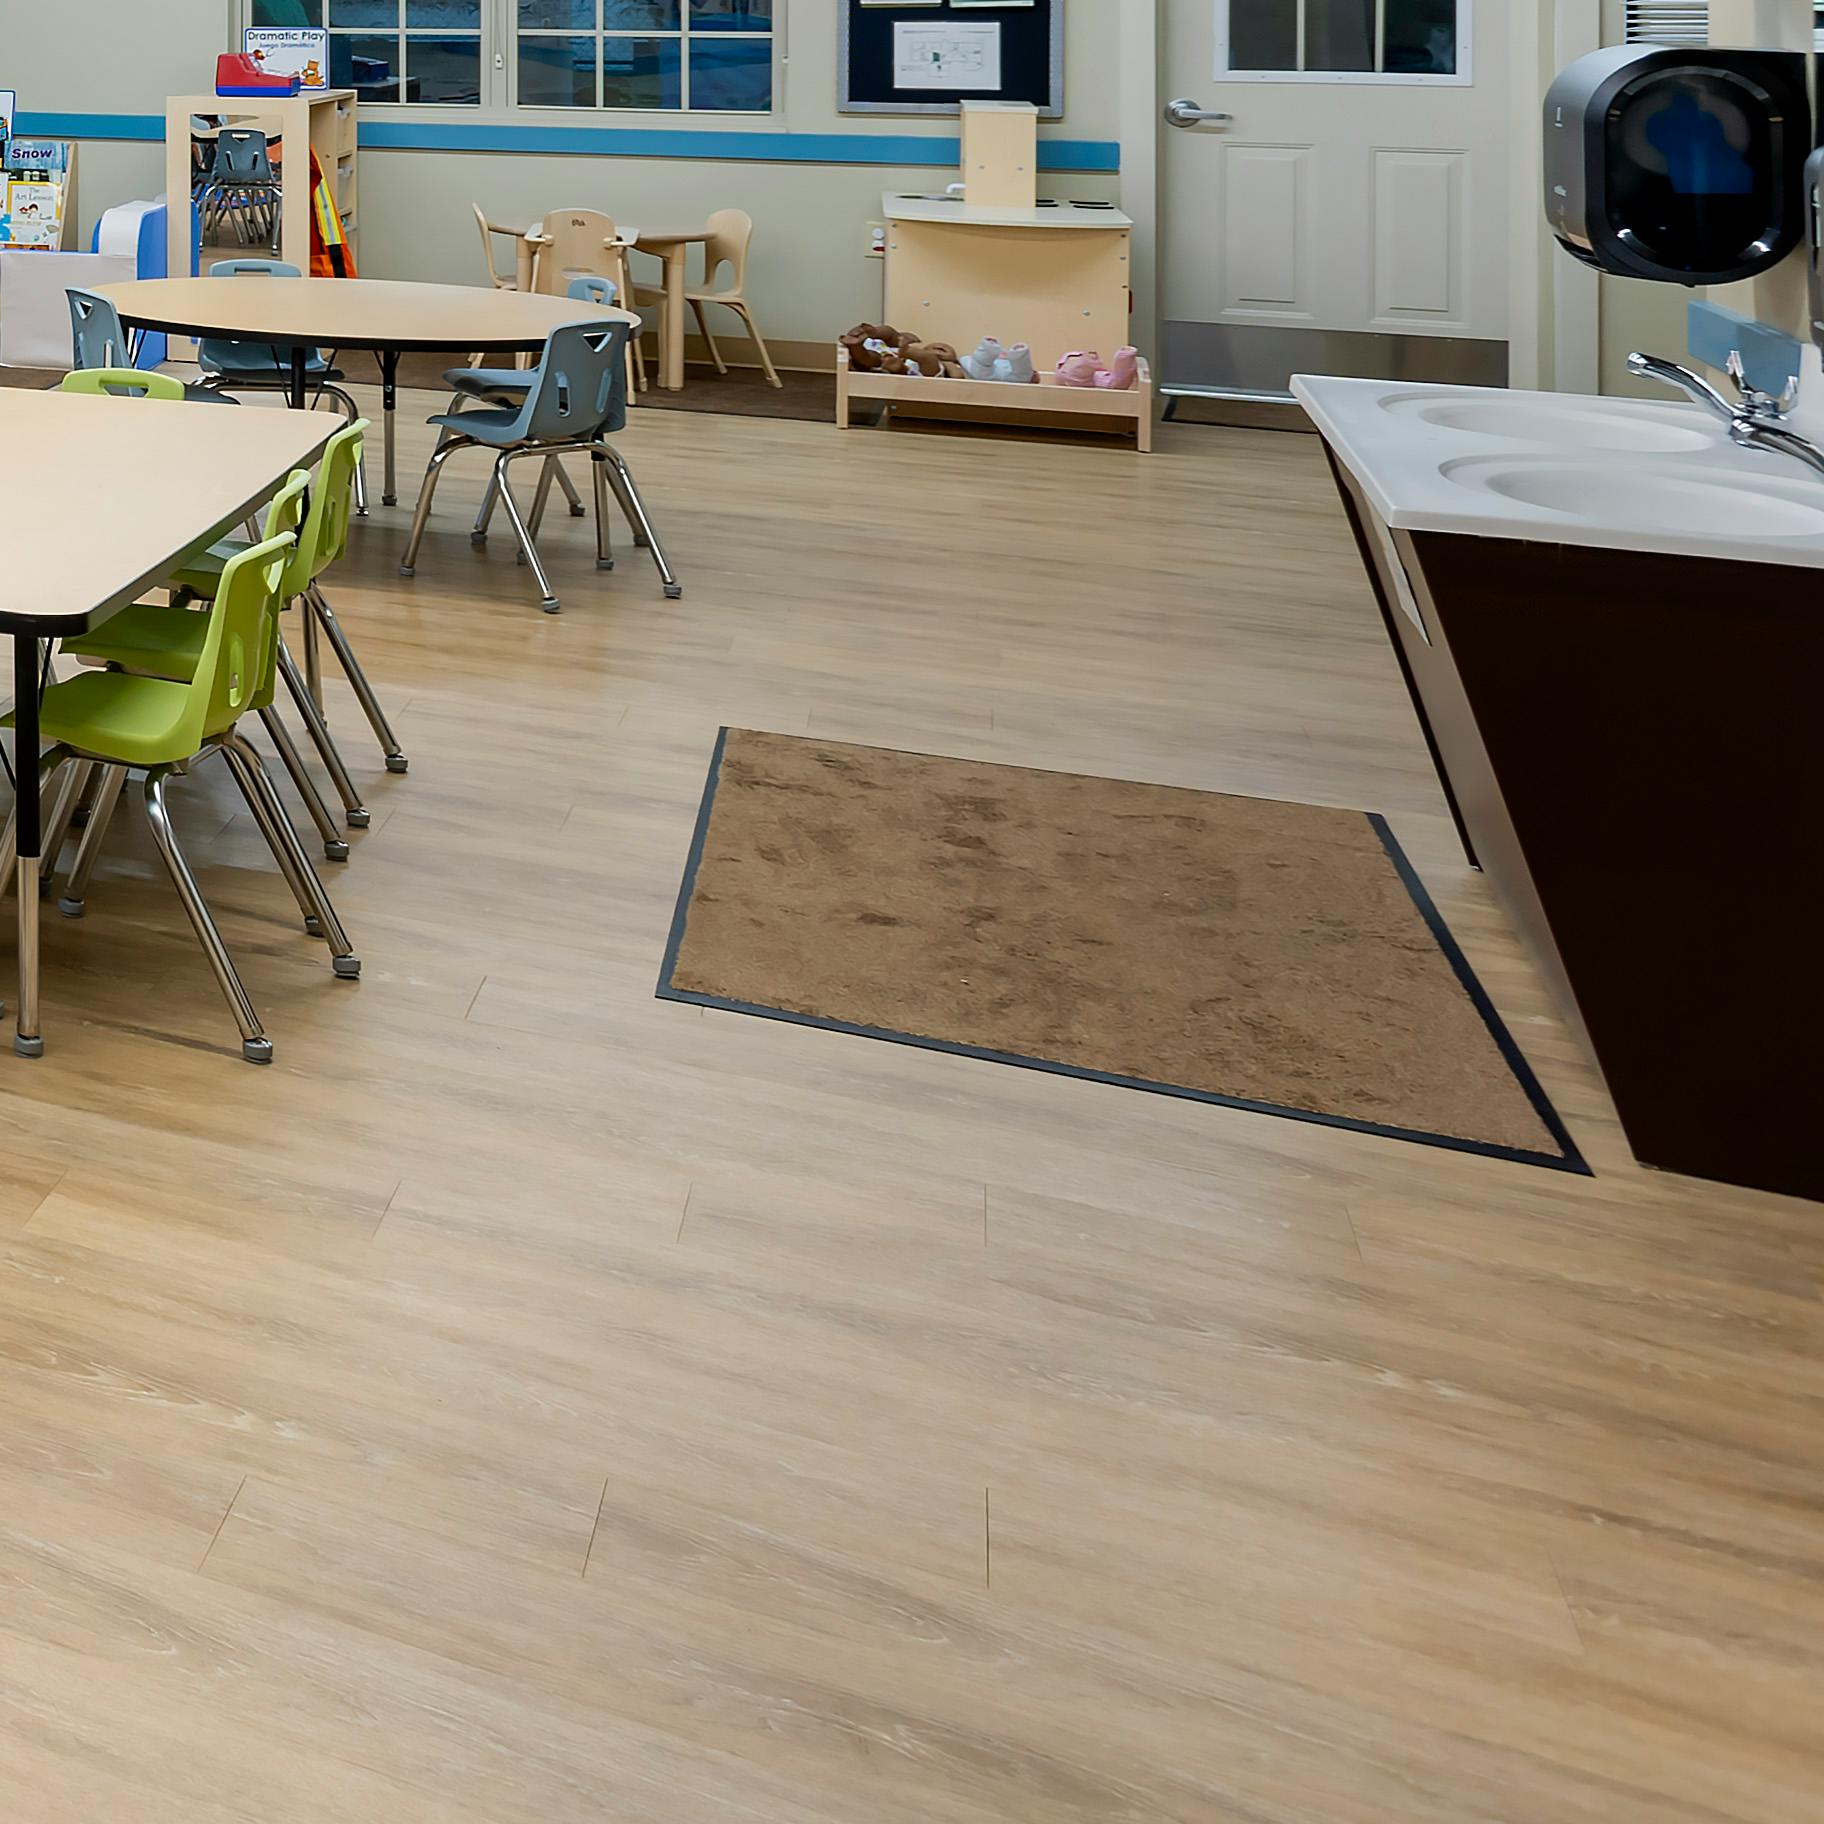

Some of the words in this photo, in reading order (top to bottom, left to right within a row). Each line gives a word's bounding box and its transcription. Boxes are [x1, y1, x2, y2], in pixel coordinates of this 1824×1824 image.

[248, 31, 299, 41] Dramatic
[301, 31, 325, 42] Play
[11, 148, 53, 159] Snow
